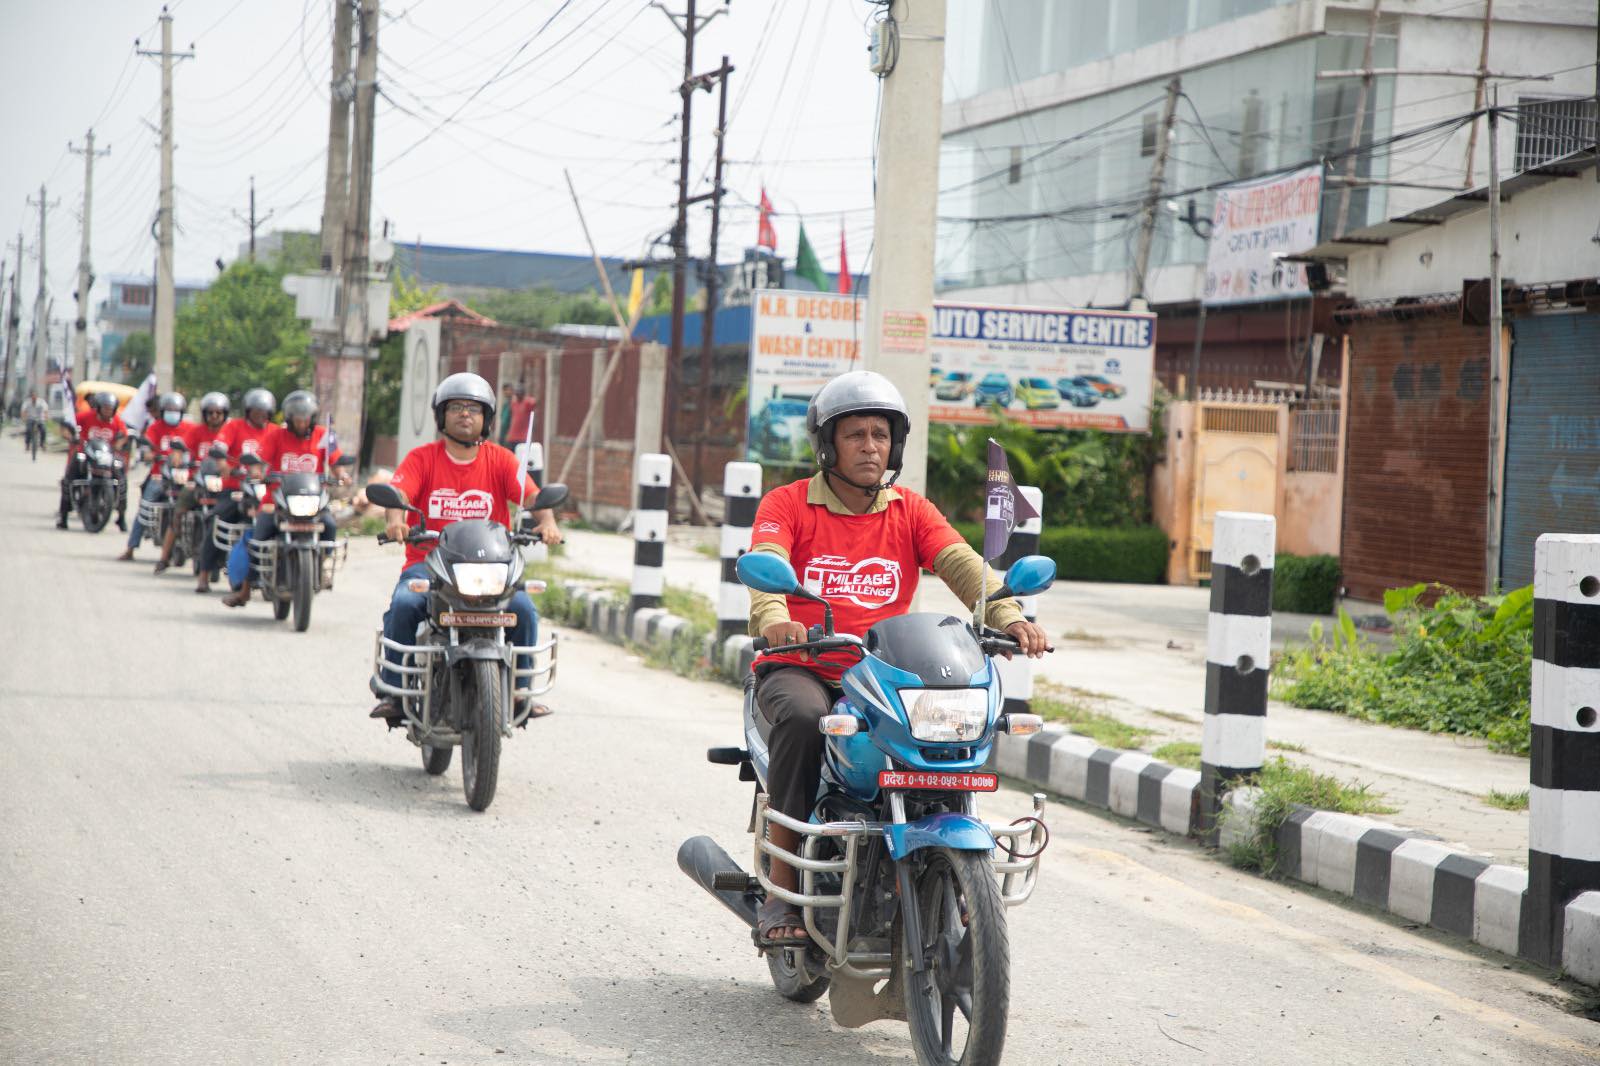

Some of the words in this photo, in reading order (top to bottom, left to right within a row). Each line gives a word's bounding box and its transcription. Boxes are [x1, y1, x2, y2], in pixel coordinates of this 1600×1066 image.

[796, 296, 863, 321] DECORE
[982, 311, 1069, 342] SERVICE
[1072, 316, 1150, 347] CENTRE
[758, 335, 803, 356] WASH
[807, 337, 862, 360] CENTRE
[825, 585, 893, 597] CHALLENGE
[827, 573, 892, 585] MILEAGE
